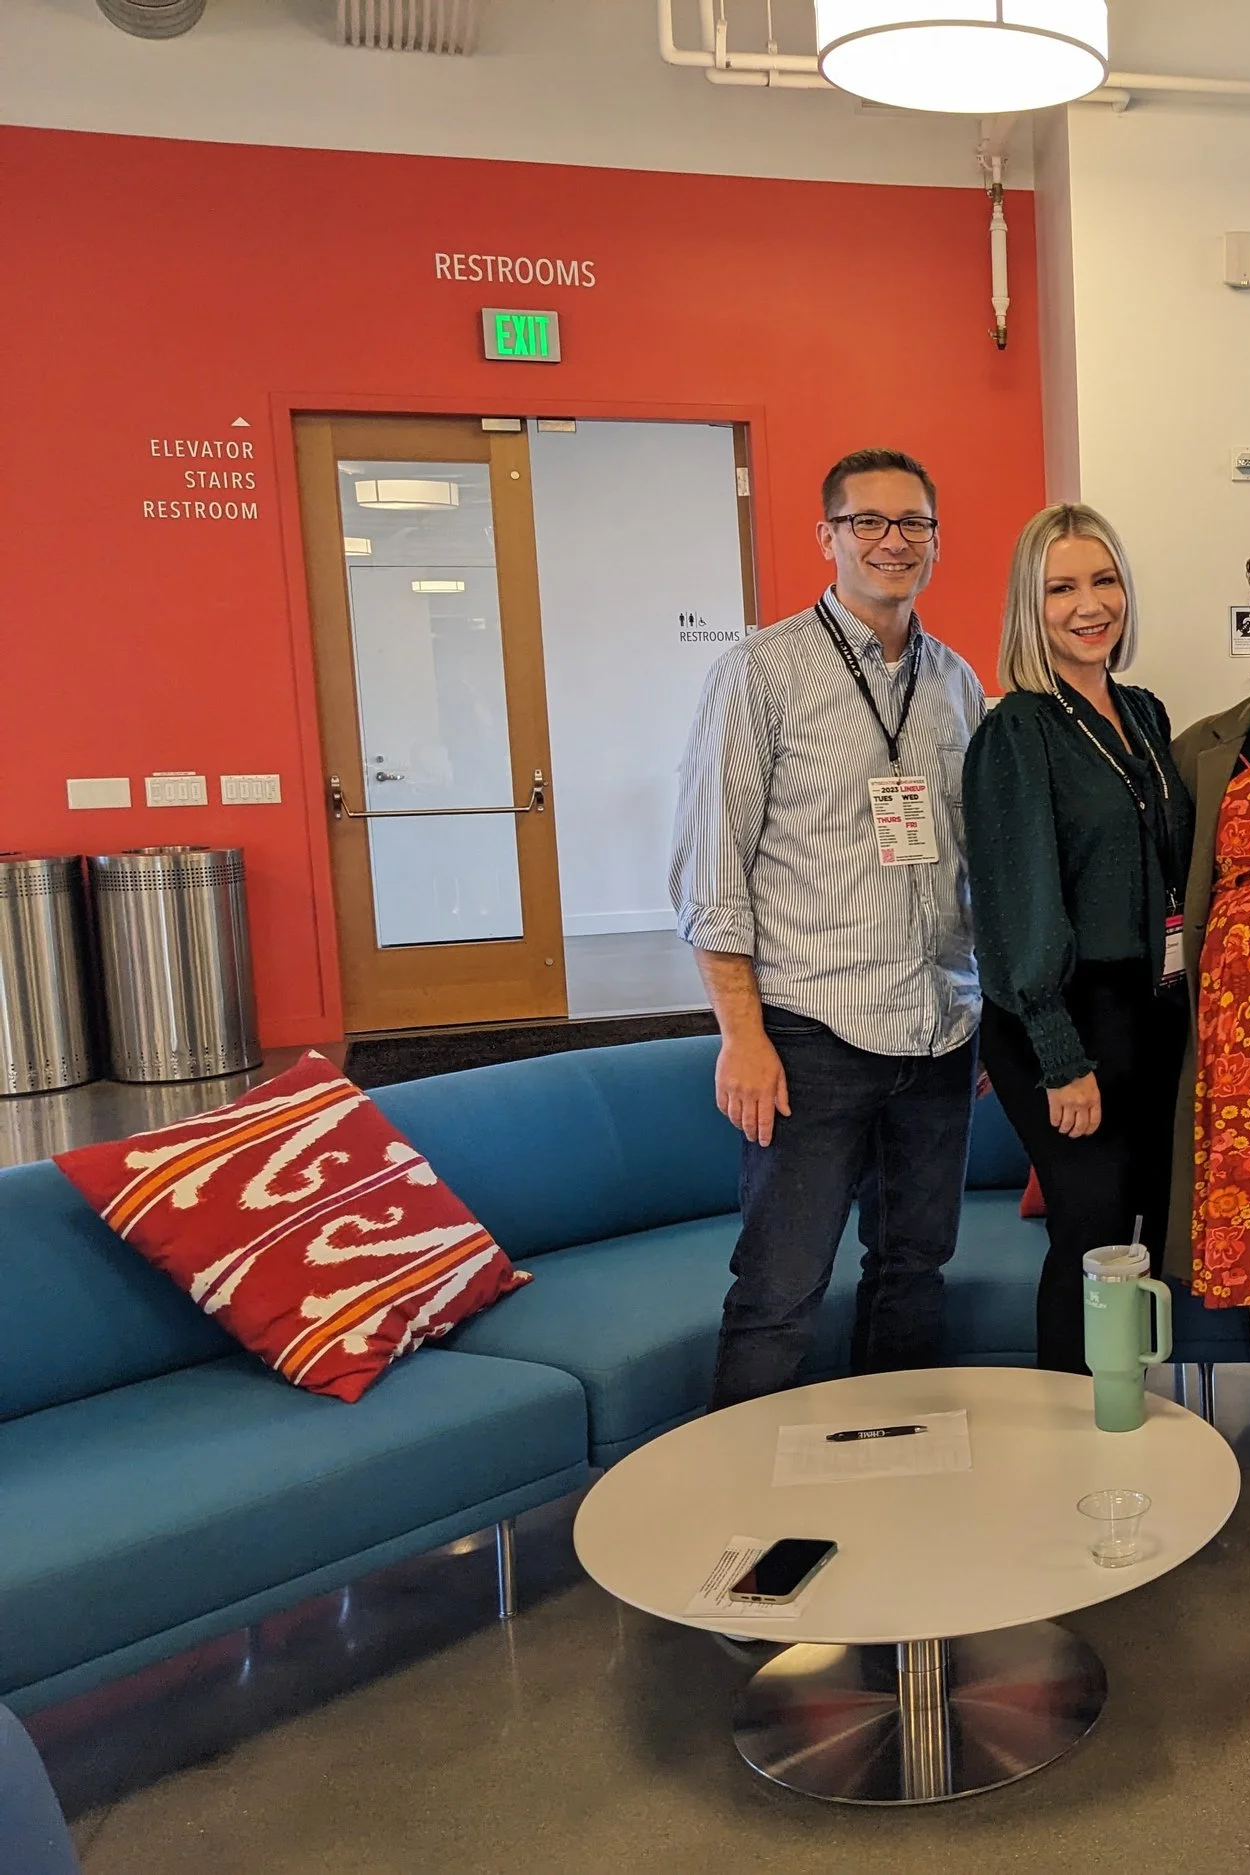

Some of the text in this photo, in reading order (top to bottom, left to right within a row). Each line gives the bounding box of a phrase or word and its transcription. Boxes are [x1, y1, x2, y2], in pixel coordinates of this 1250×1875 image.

[435, 253, 596, 288] RESTROOMS
[495, 314, 550, 357] EXIT
[150, 439, 254, 459] ELEVATOR
[184, 470, 256, 490] STAIRS
[143, 500, 258, 520] RESTROOM
[679, 631, 740, 642] RESTROOMS
[900, 785, 926, 793] LINEUP
[876, 816, 902, 824] THURS
